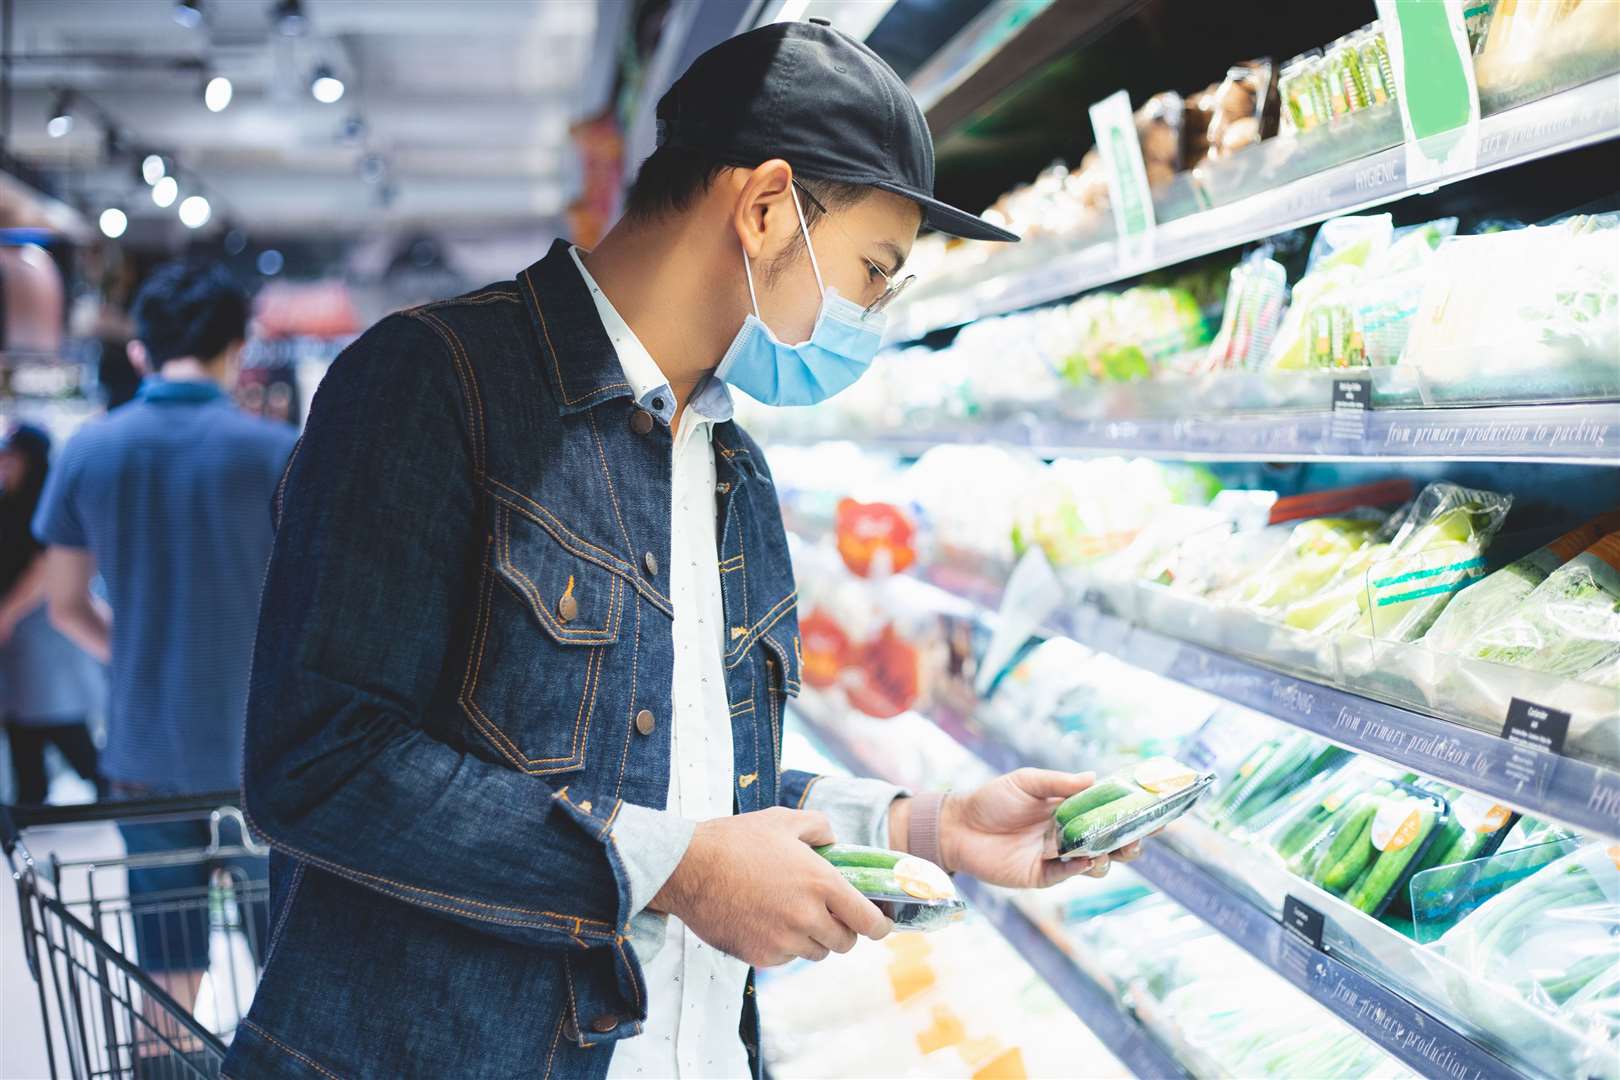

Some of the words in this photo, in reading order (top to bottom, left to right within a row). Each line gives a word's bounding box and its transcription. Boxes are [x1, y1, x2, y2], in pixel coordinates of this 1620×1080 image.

[1384, 421, 1411, 447] from
[1413, 423, 1460, 447] primary
[1461, 419, 1529, 447] production
[1533, 423, 1547, 441] to
[1549, 417, 1609, 447] packing
[1334, 706, 1361, 731] from
[1360, 719, 1407, 745] primary
[1405, 735, 1470, 766] production
[1329, 977, 1358, 1007] from
[1357, 998, 1405, 1040] primary
[1402, 1031, 1468, 1080] production
